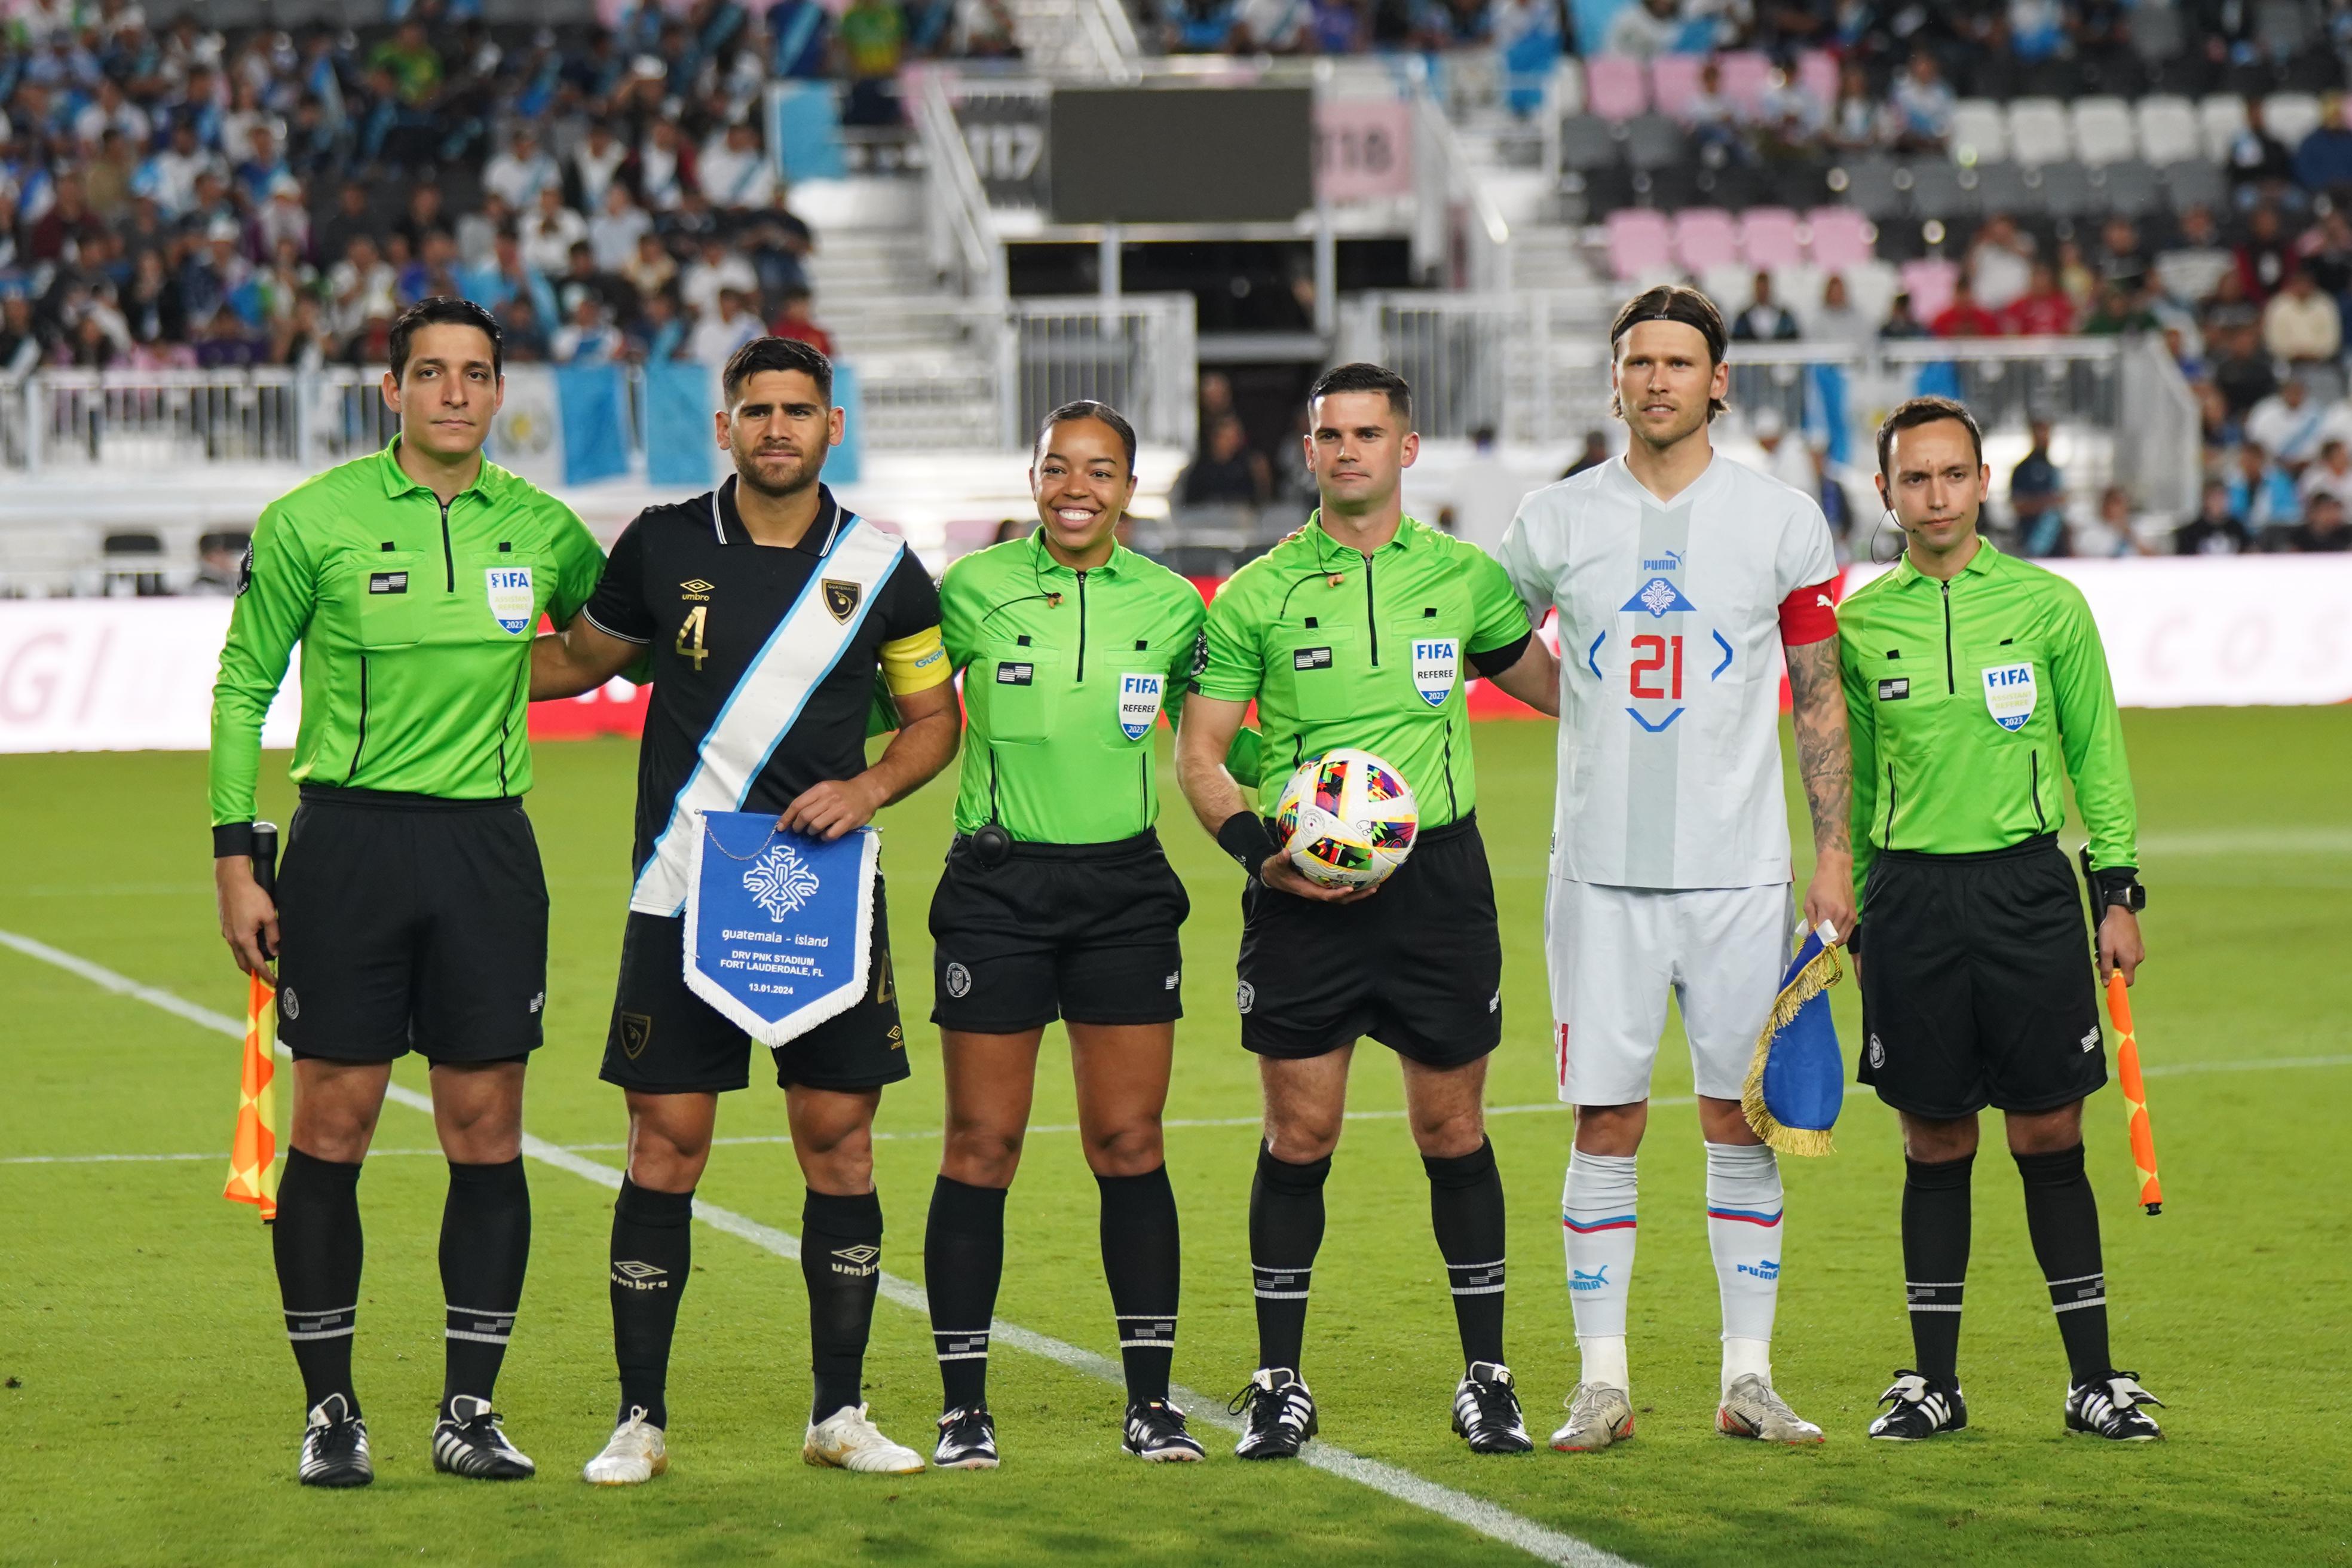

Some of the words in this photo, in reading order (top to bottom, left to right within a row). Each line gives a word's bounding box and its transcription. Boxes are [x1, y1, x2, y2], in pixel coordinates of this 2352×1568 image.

[1644, 559, 1676, 571] PUMA
[491, 572, 529, 588] FIFA
[827, 583, 857, 592] GUATEMALA
[682, 593, 710, 602] umbro
[506, 621, 524, 629] 2023
[676, 606, 709, 671] 4
[1417, 644, 1454, 660] FIFA
[1417, 669, 1454, 679] REFEREE
[1630, 635, 1683, 700] 21
[1988, 669, 2030, 687] FIFA
[1125, 678, 1159, 694] FIFA
[1428, 691, 1445, 700] 2023
[1992, 690, 2032, 702] ASSISTANT
[1123, 704, 1156, 713] REFEREE
[1995, 699, 2029, 709] REFEREE
[2004, 716, 2023, 727] 2023
[1128, 725, 1144, 734] 2023
[722, 929, 782, 943] guatemala
[732, 950, 752, 960] DRV
[753, 952, 773, 961] PNK
[774, 954, 814, 966] STADIUM
[720, 959, 745, 969] FORT
[746, 961, 811, 976] LAUDERDALE,
[813, 968, 825, 977] FL
[749, 982, 794, 995] 13.01.2024
[1737, 1264, 1778, 1280] PUMA
[611, 1272, 668, 1290] umbro
